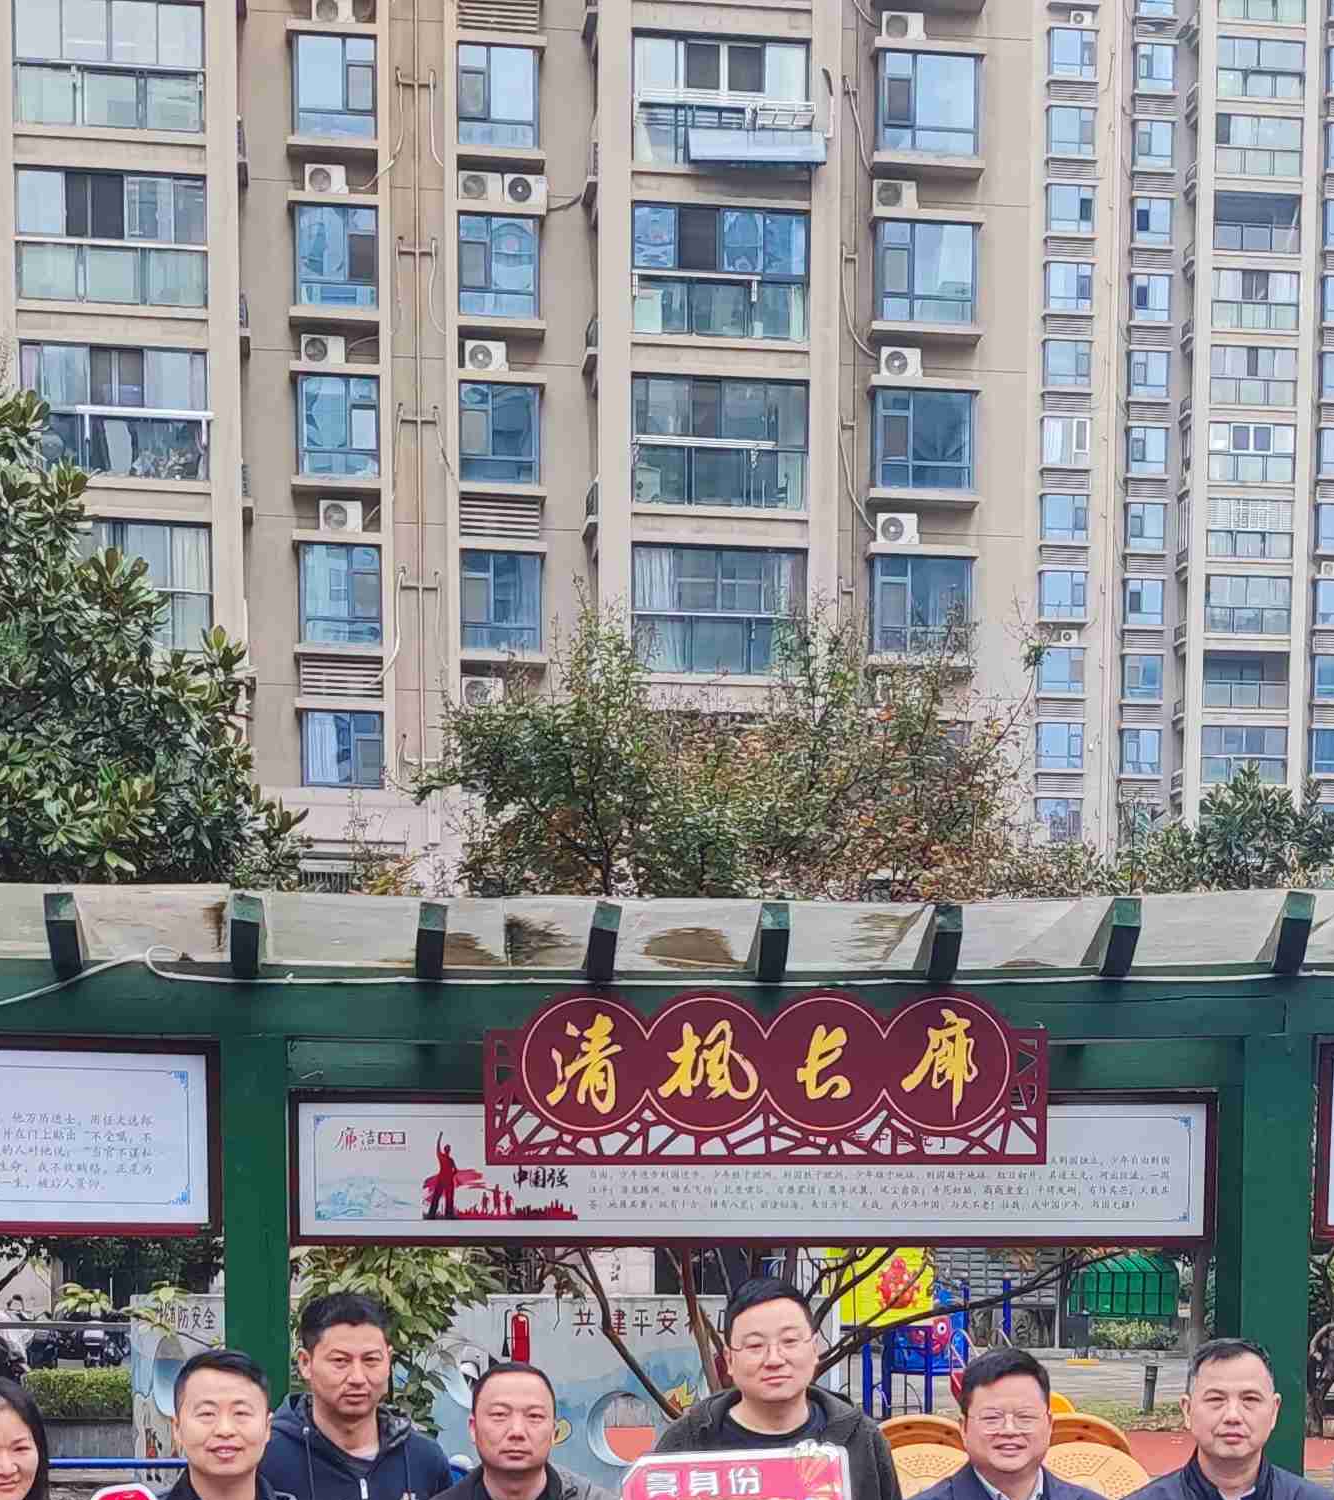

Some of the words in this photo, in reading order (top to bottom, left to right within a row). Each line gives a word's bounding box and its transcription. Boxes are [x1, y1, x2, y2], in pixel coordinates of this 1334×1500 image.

[546, 1008, 980, 1120] 清枫长廊
[572, 1308, 726, 1337] 共建平安
